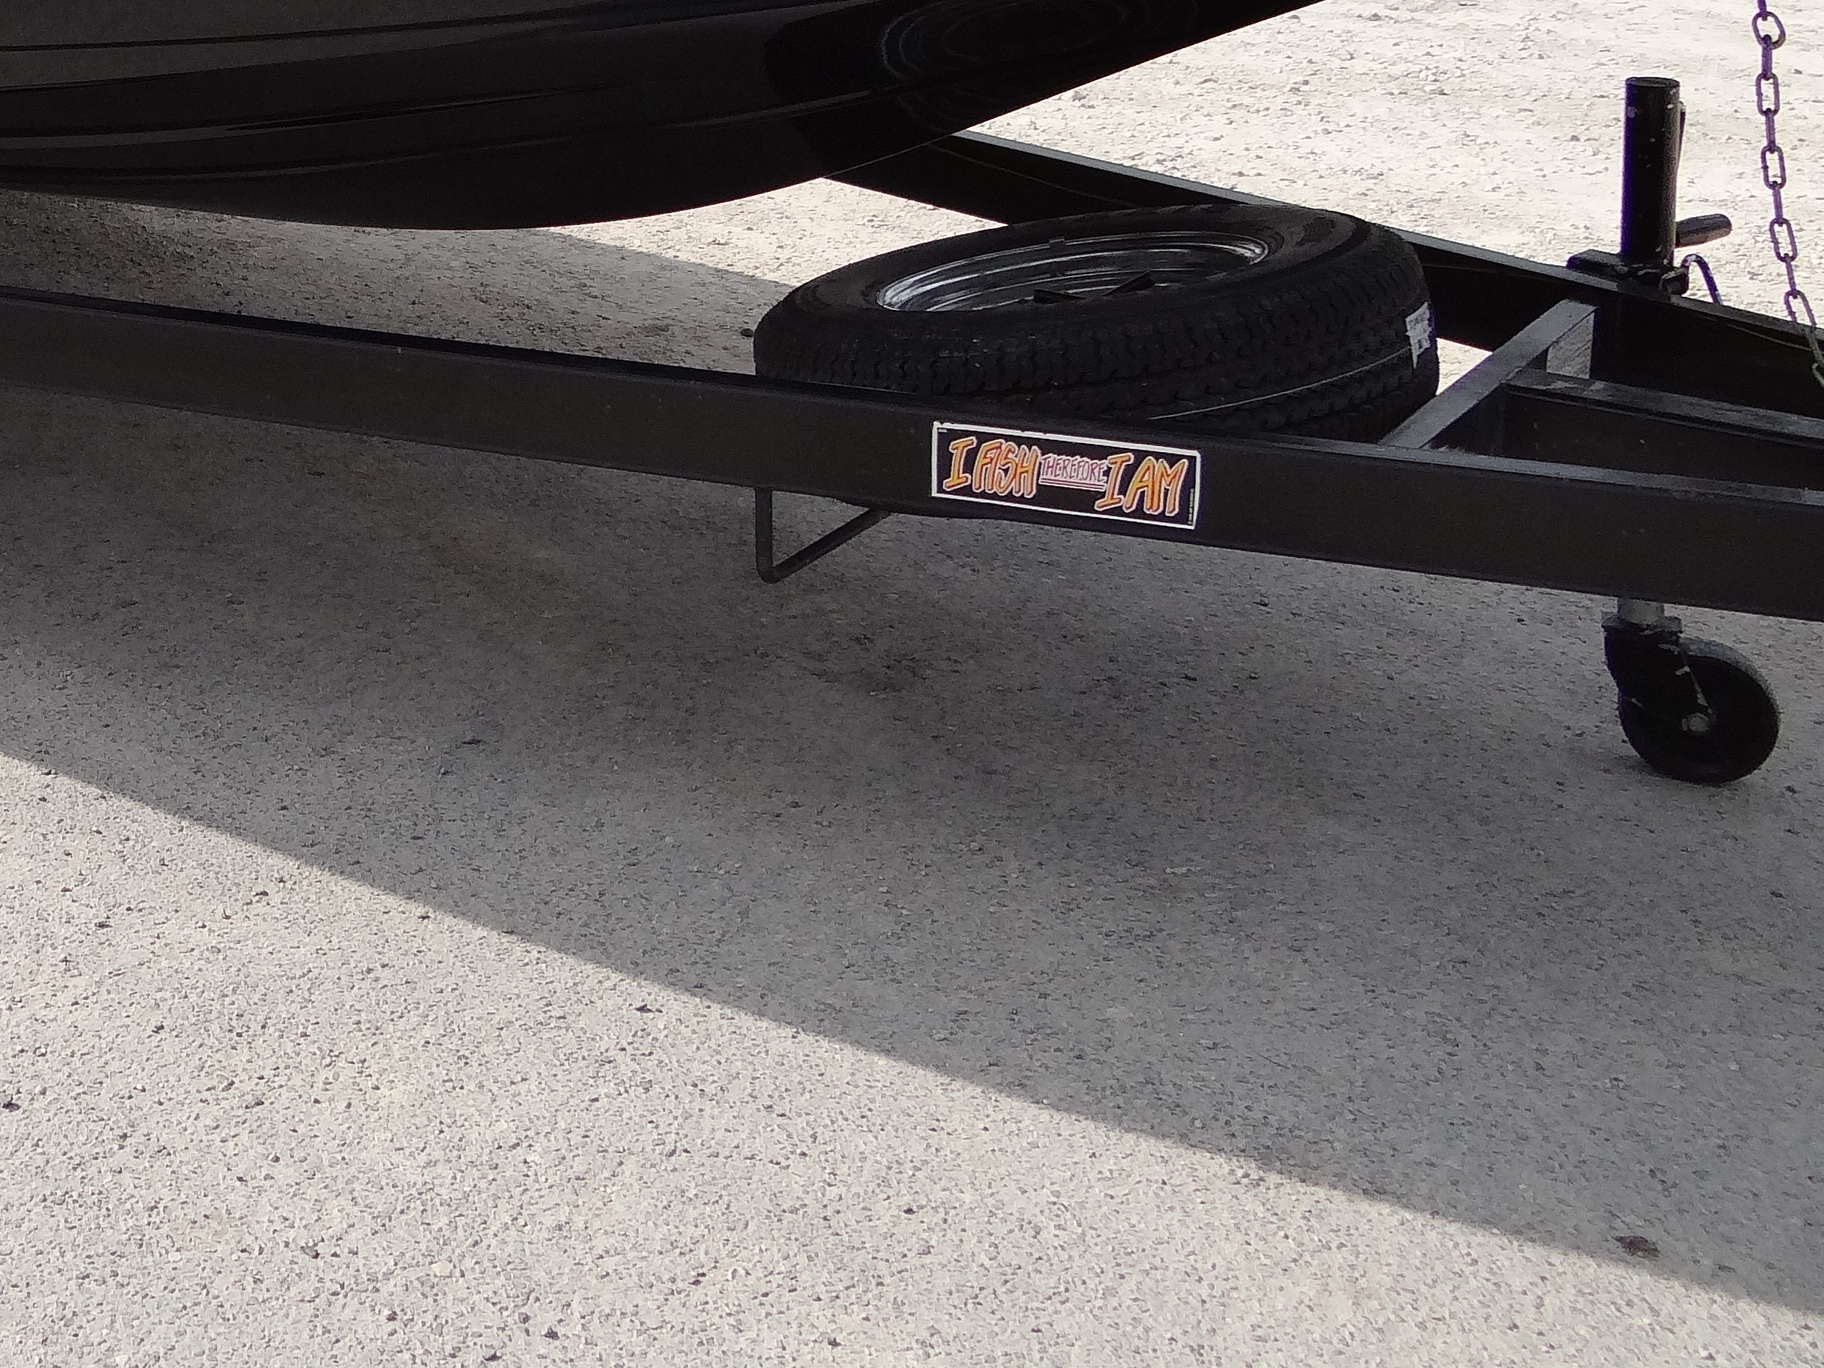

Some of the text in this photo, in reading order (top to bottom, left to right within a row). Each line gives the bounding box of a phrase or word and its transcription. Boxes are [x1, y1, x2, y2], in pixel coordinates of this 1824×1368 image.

[943, 436, 976, 491] I
[972, 438, 1042, 499] FISH
[1040, 453, 1108, 483] THEREFORE
[1094, 452, 1134, 511] I
[1122, 456, 1189, 516] AM
